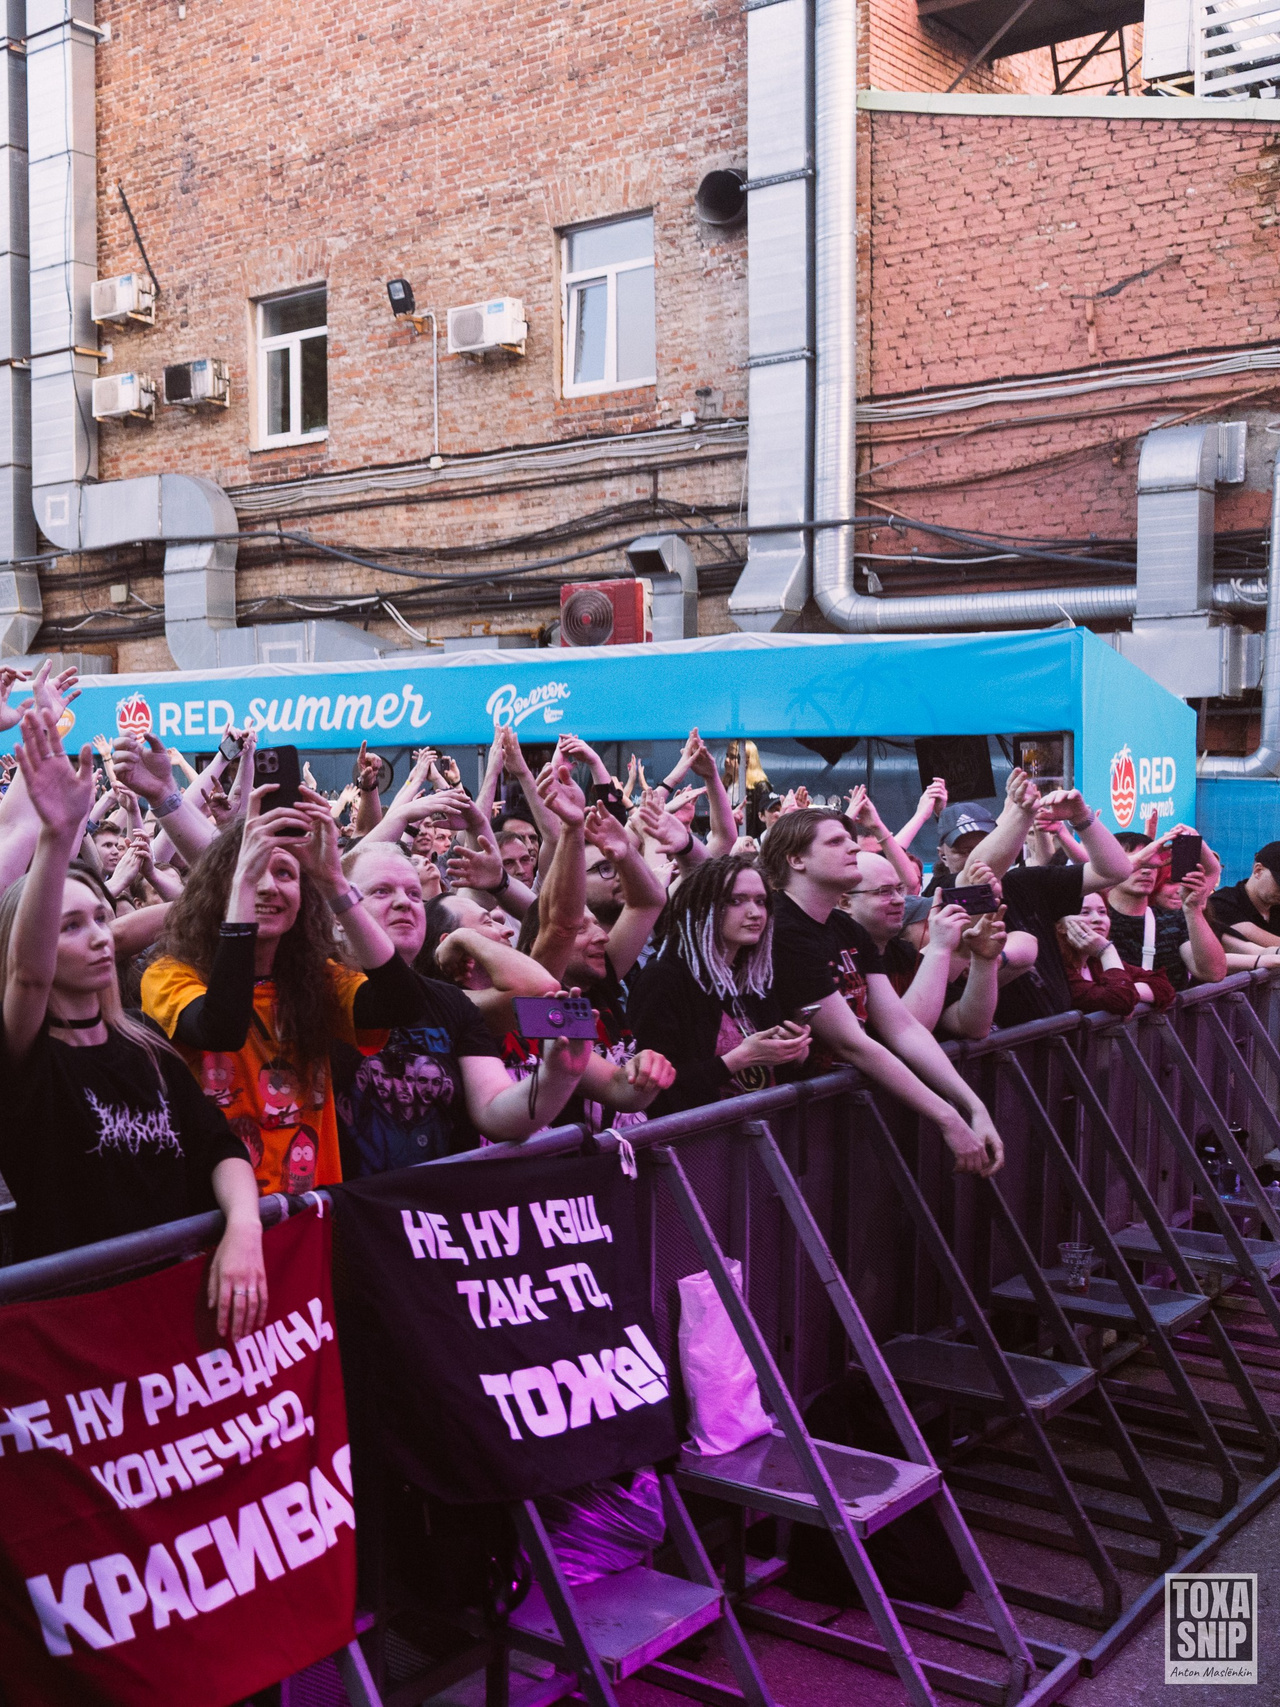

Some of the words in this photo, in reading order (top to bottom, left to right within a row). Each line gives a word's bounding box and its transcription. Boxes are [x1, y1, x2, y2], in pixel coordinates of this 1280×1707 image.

[159, 699, 235, 736] RED
[244, 683, 432, 732] summer
[1139, 756, 1177, 795] RED
[1139, 797, 1176, 820] summer
[400, 1209, 469, 1266] НЕ,
[461, 1206, 519, 1260] НУ
[529, 1195, 613, 1249] КЭШ,
[456, 1262, 613, 1329] ТАК-ТО,
[66, 1381, 127, 1445] НУ
[90, 1390, 315, 1511] КОНЕЧНО,
